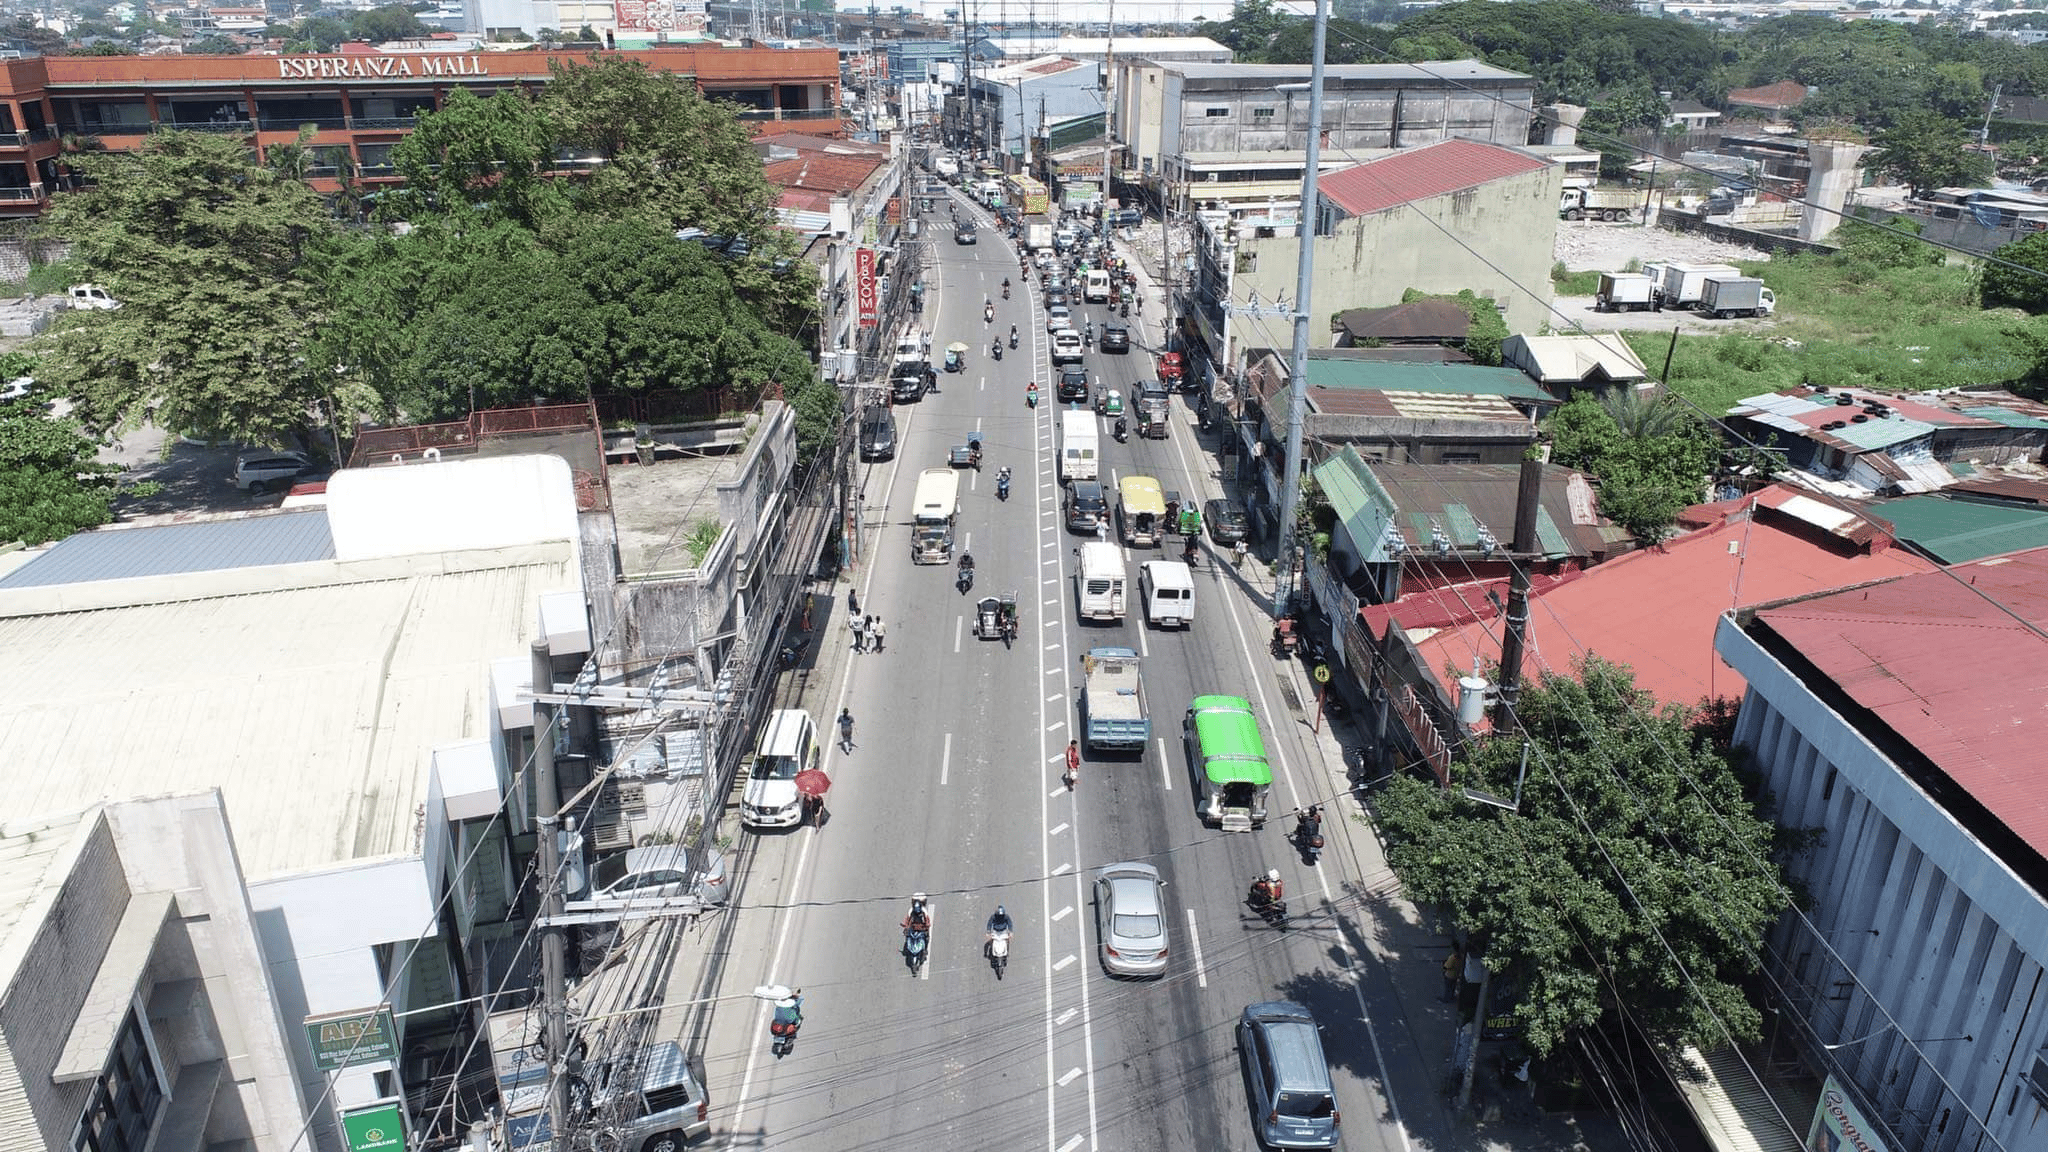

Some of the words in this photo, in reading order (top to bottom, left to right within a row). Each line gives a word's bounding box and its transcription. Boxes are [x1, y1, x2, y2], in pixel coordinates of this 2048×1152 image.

[278, 57, 412, 78] ESPERANZA
[421, 56, 488, 76] MALL
[861, 255, 873, 309] PBCOM
[861, 313, 876, 321] ATM
